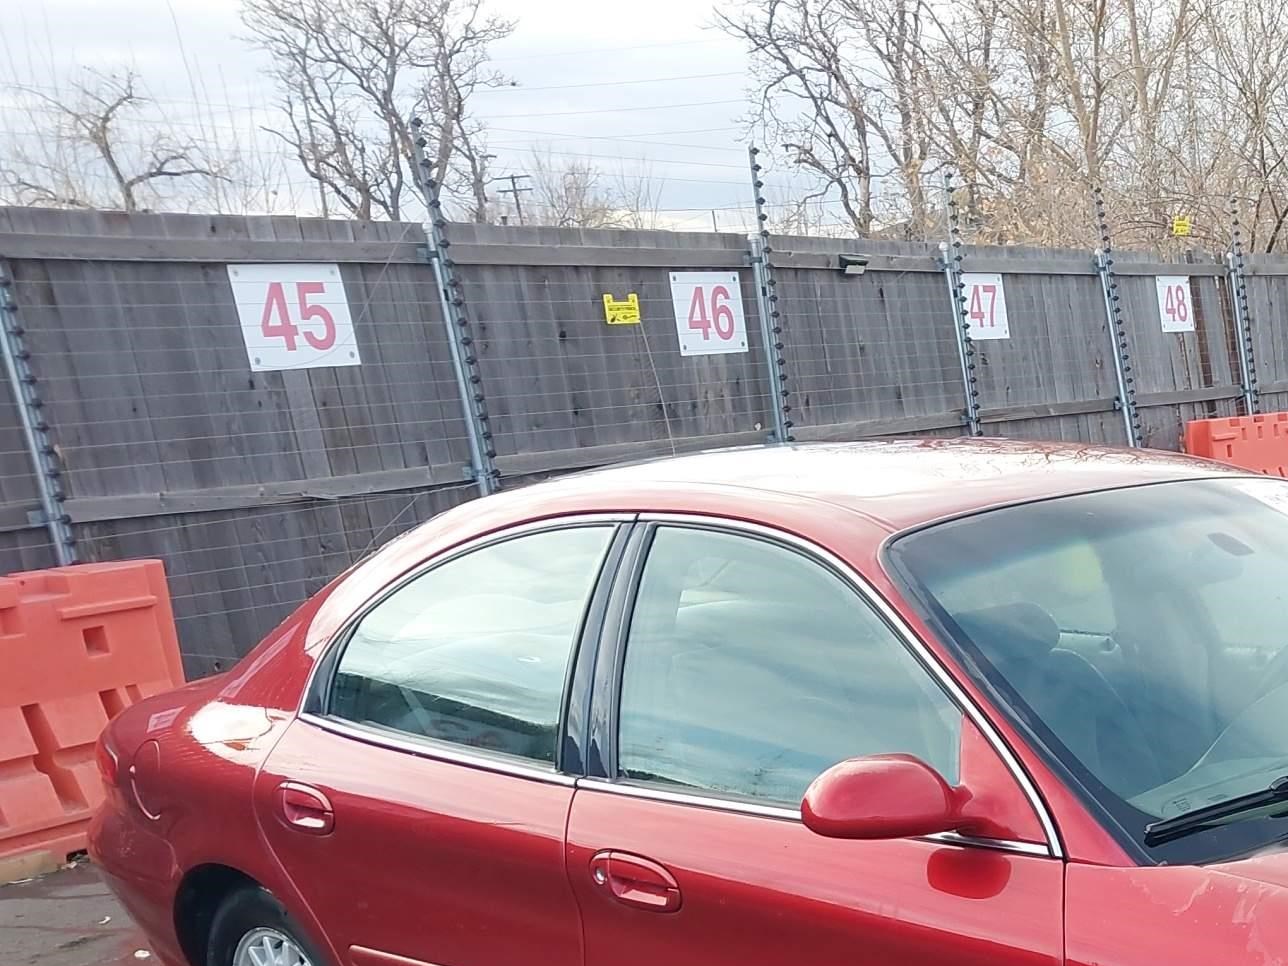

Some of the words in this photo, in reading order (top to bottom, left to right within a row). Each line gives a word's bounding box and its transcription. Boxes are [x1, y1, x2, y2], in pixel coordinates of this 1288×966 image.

[261, 281, 337, 352] 45
[688, 285, 735, 341] 46
[970, 284, 997, 329] 47
[1165, 284, 1188, 323] 48
